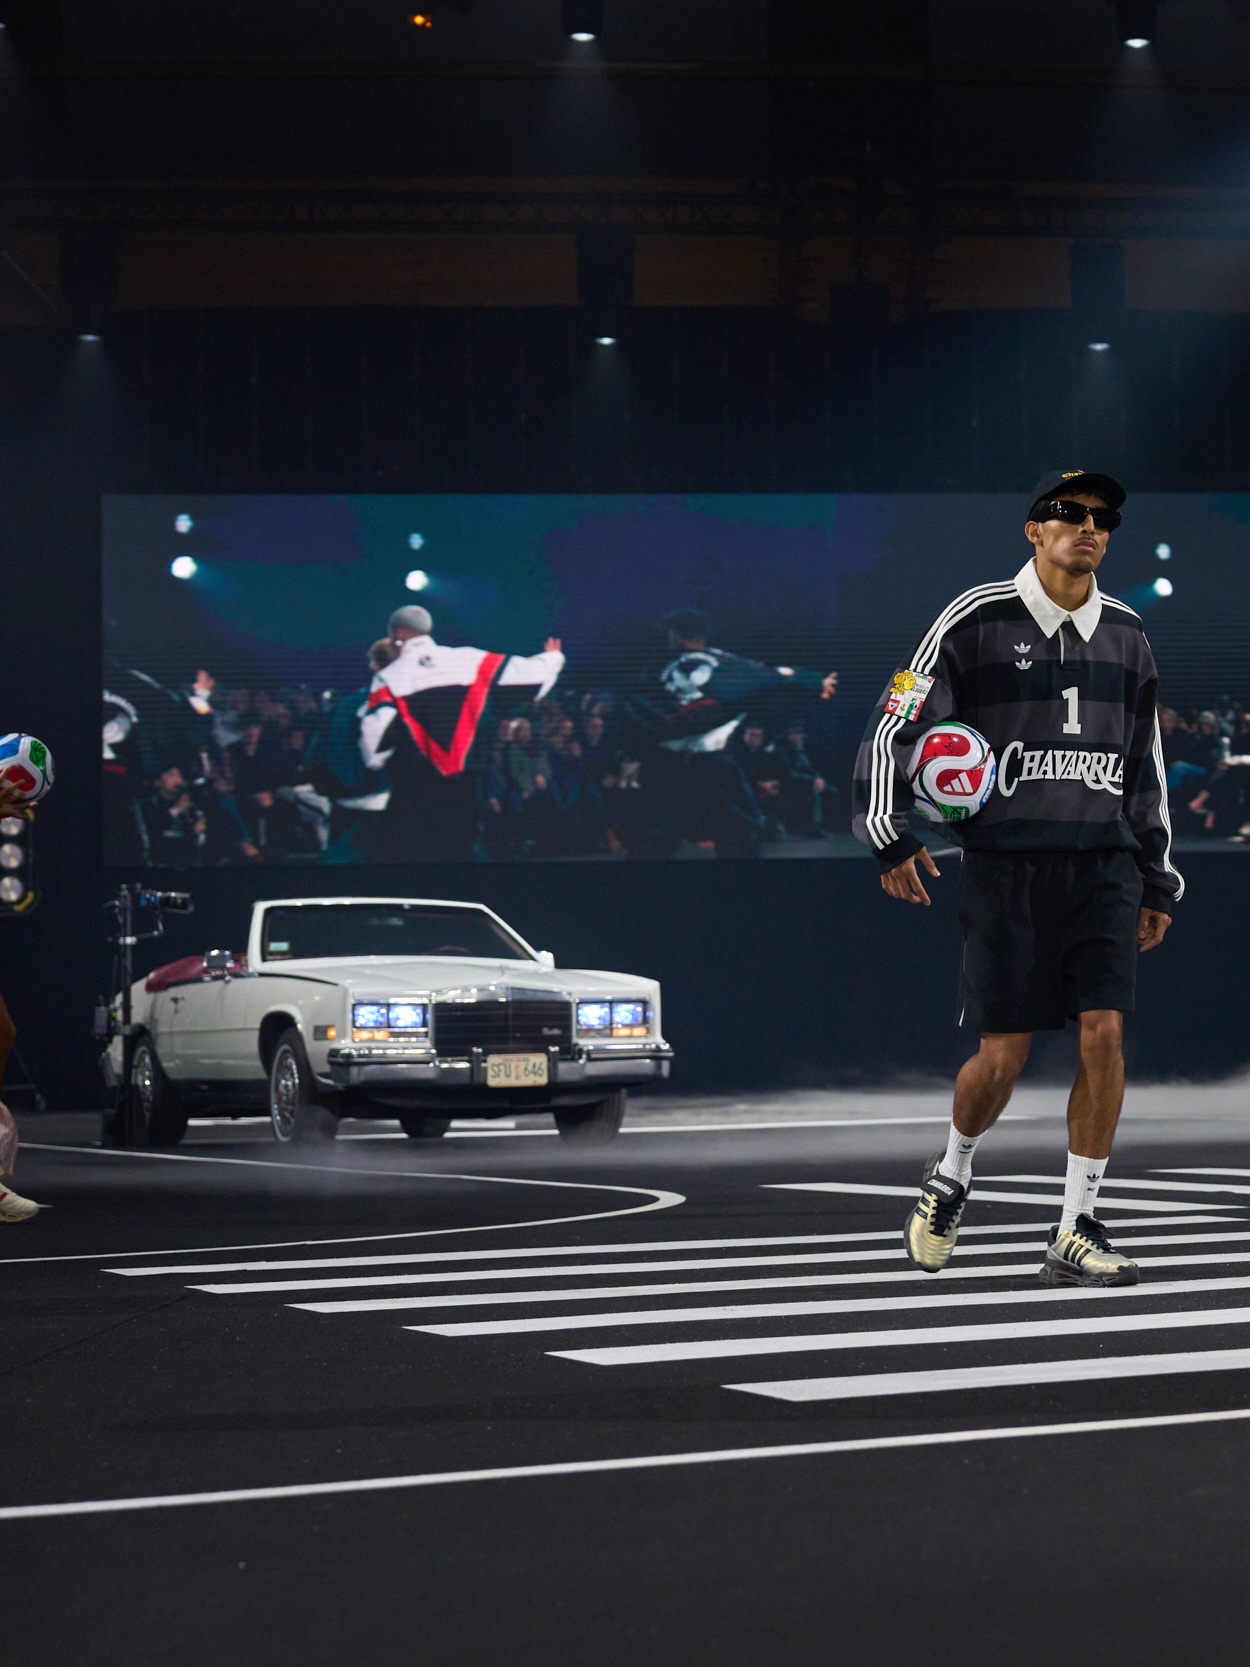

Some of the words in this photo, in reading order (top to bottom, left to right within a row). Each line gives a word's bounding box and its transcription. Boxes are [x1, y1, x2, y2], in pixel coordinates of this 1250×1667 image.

[1061, 686, 1081, 734] 1
[490, 1062, 512, 1079] SFU
[523, 1061, 544, 1078] 646
